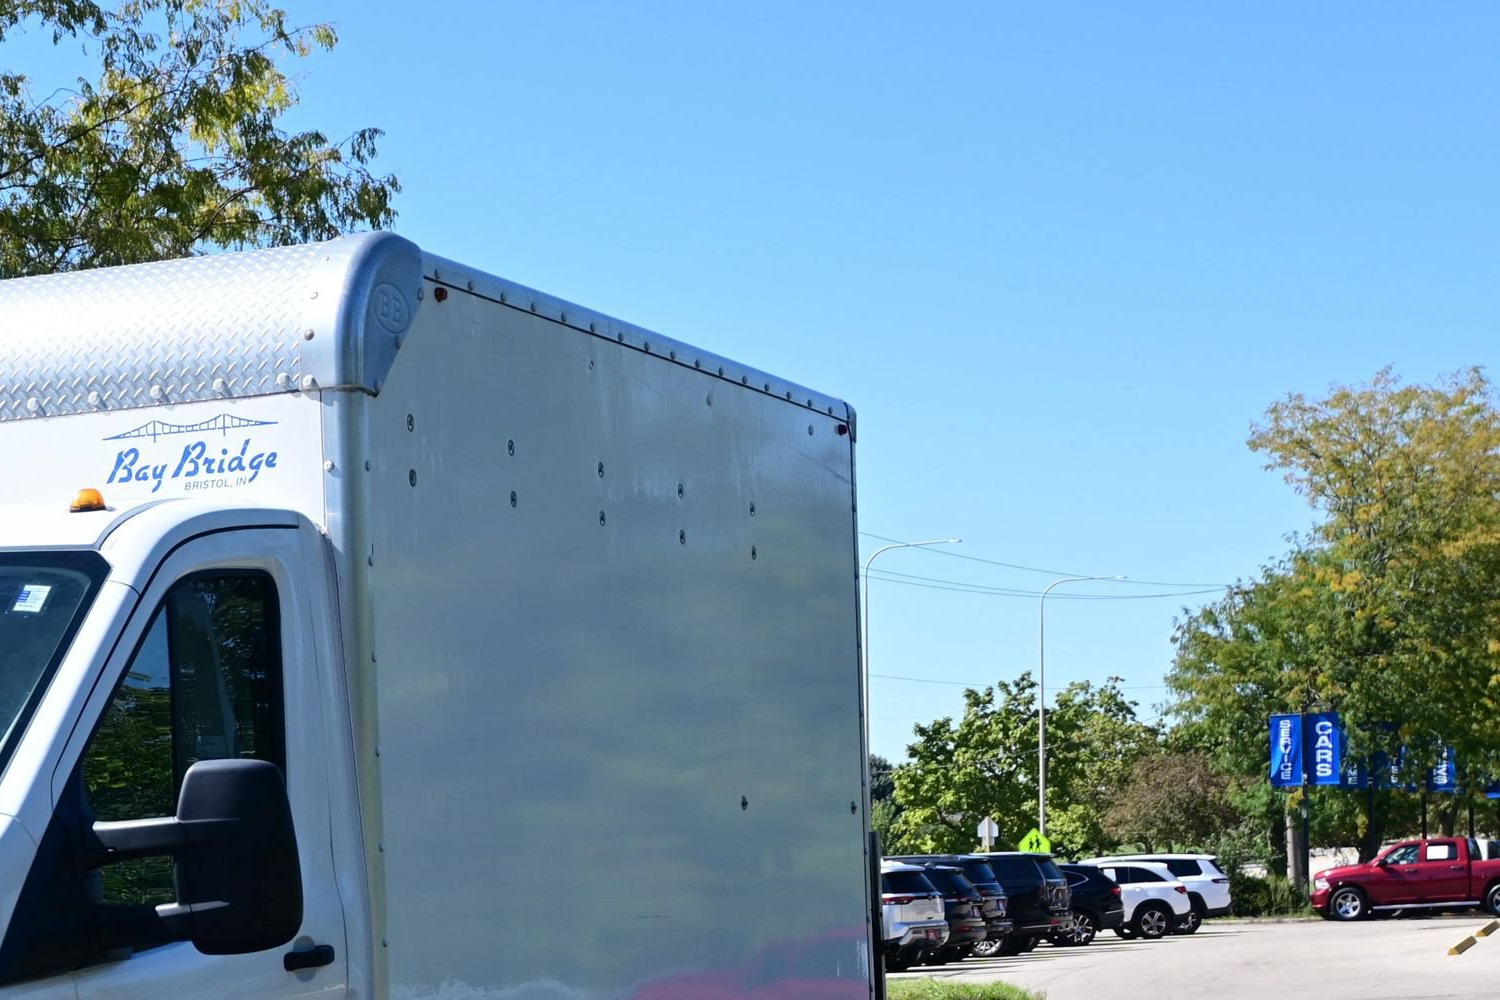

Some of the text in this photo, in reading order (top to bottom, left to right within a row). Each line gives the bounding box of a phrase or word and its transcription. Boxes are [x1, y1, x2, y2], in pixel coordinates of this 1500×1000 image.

[106, 438, 278, 493] Bay Bridge
[184, 476, 248, 491] BRISTOL, IN
[1279, 719, 1293, 780] SERVICE
[1315, 720, 1333, 777] CARS
